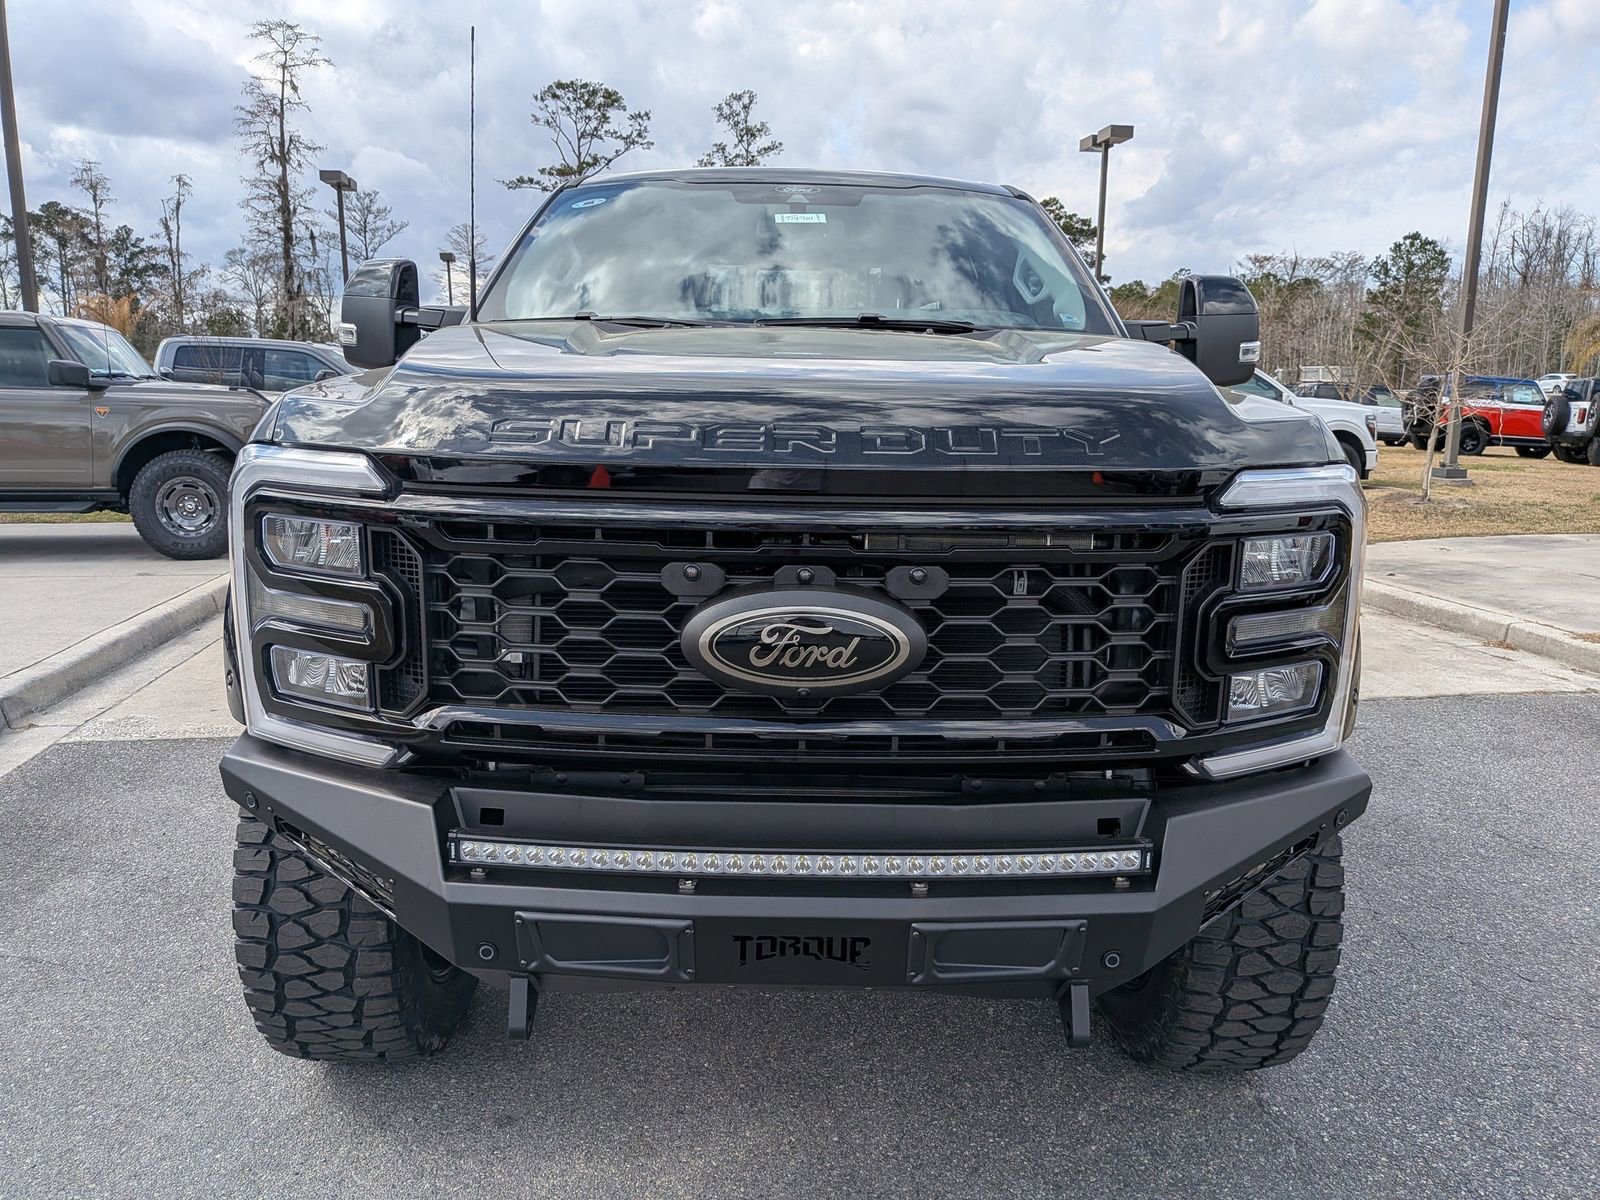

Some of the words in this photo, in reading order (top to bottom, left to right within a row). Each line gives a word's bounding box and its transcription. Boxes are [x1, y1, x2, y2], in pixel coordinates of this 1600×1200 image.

[488, 418, 838, 453] SUPER
[860, 426, 1121, 455] DUTY
[749, 623, 861, 668] Ford
[732, 935, 871, 969] TORQUE
